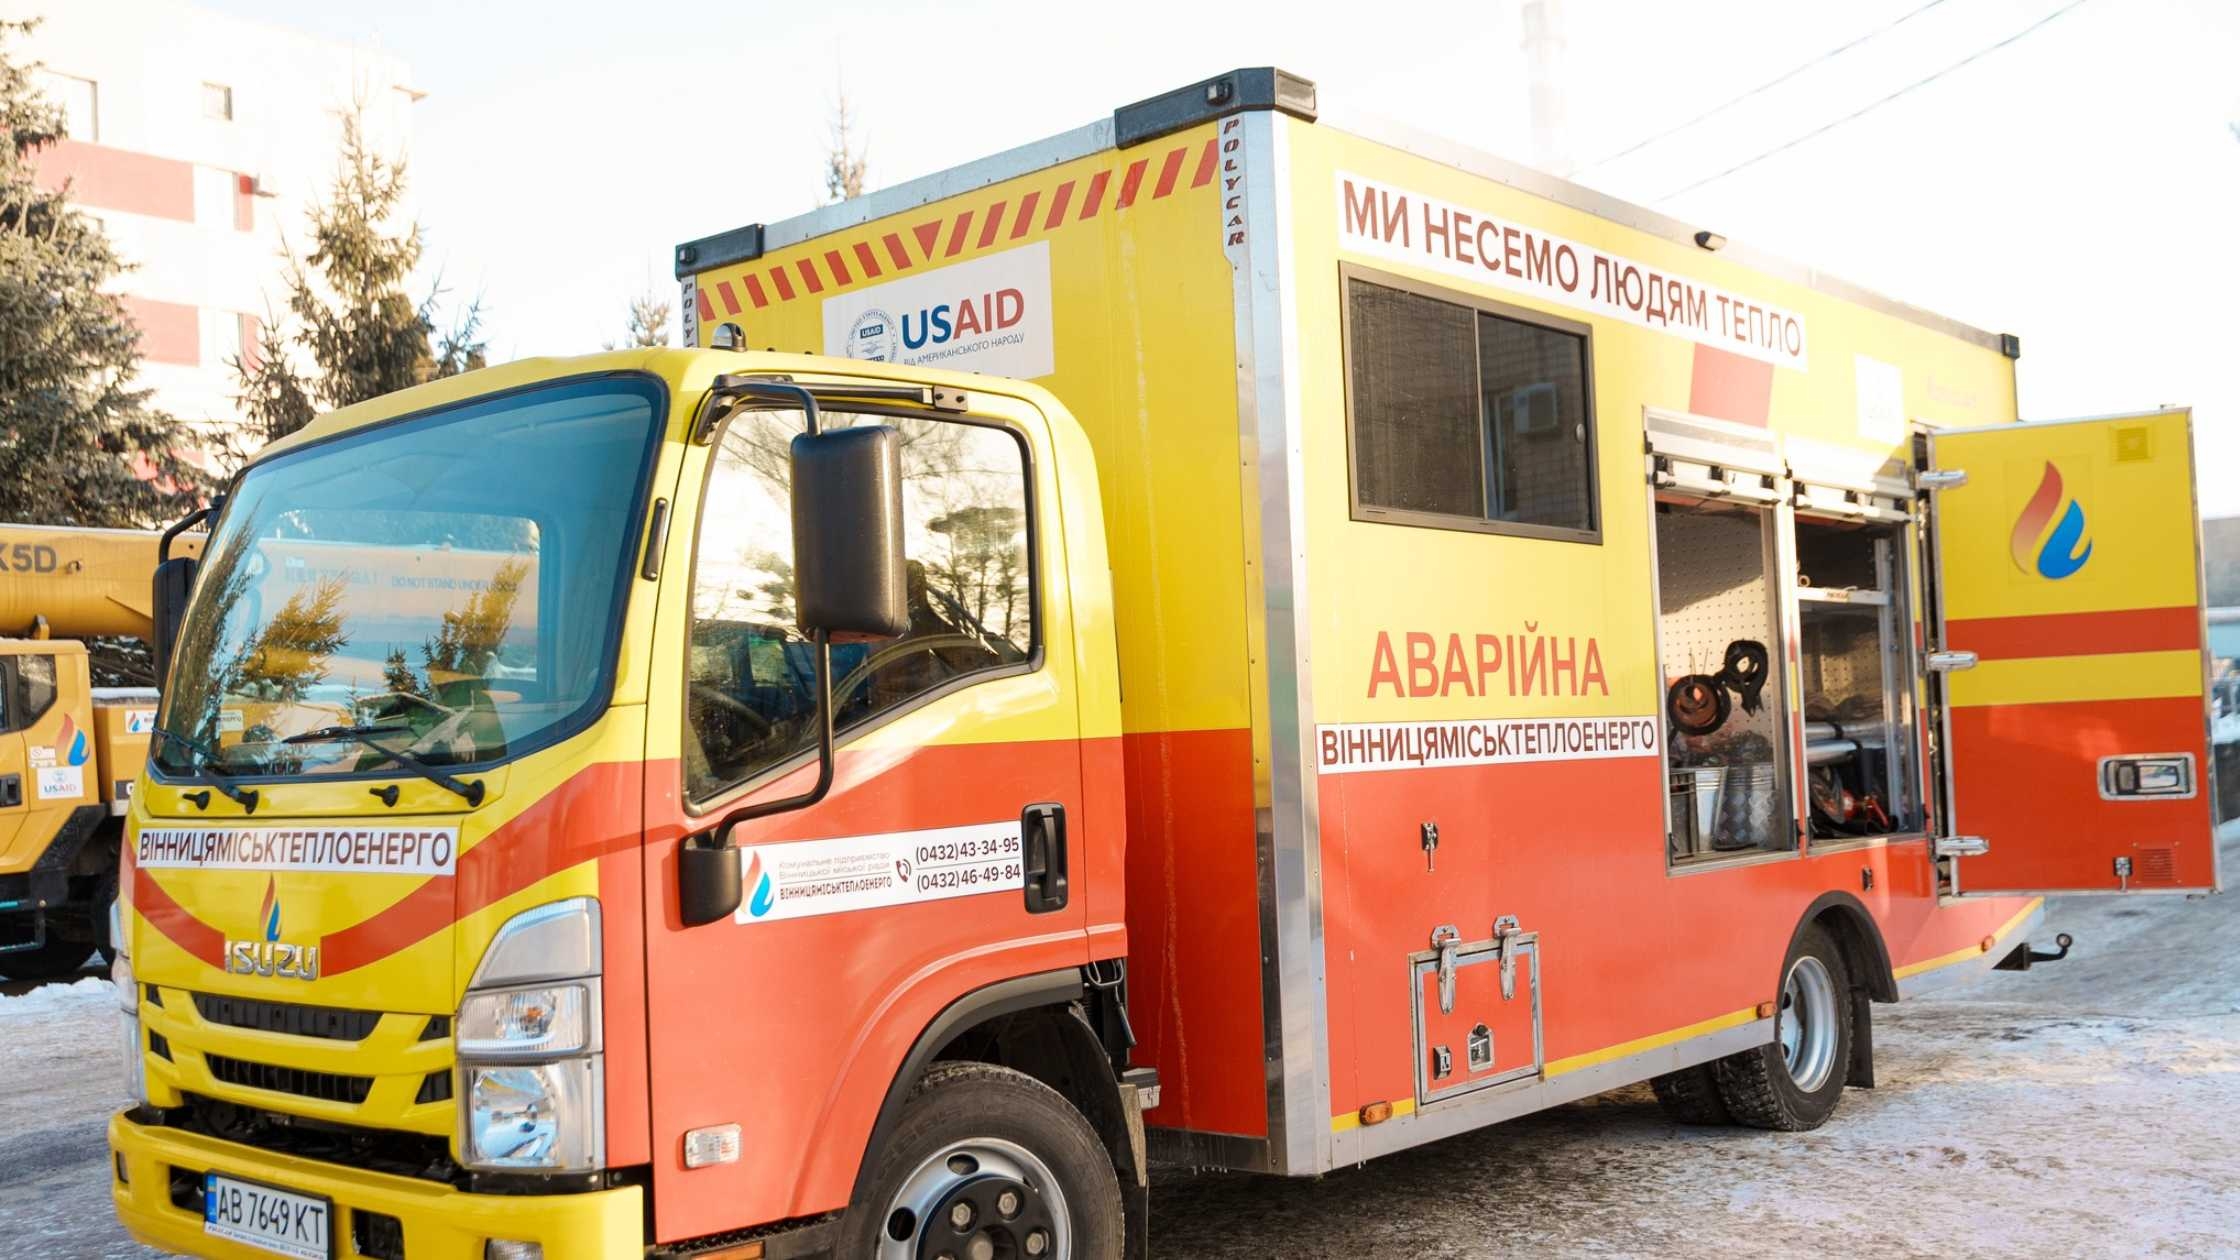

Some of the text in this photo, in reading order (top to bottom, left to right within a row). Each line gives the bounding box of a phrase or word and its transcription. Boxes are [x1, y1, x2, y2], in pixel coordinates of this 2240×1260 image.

[1223, 119, 1245, 246] POLYCAR
[1343, 179, 1802, 358] МИ НЕСЕМО ЛЮДЯМ ТЕПЛО
[901, 287, 1025, 350] USAID
[991, 331, 1025, 348] НАРОДУ
[1366, 620, 1610, 699] АВАРІЙНА
[1321, 720, 1655, 766] ВІННИЦЯМІСЬКТЕПЛОЕНЕРГО
[139, 831, 451, 868] ВІННИЦЯМІСЬКТЕПЛОЕНЕРГО
[779, 875, 893, 901] ВІННИЦЯМІСЬКТЕПЛОЕНЕРГО
[223, 939, 319, 982] ISUZU
[247, 1191, 290, 1236] 7649
